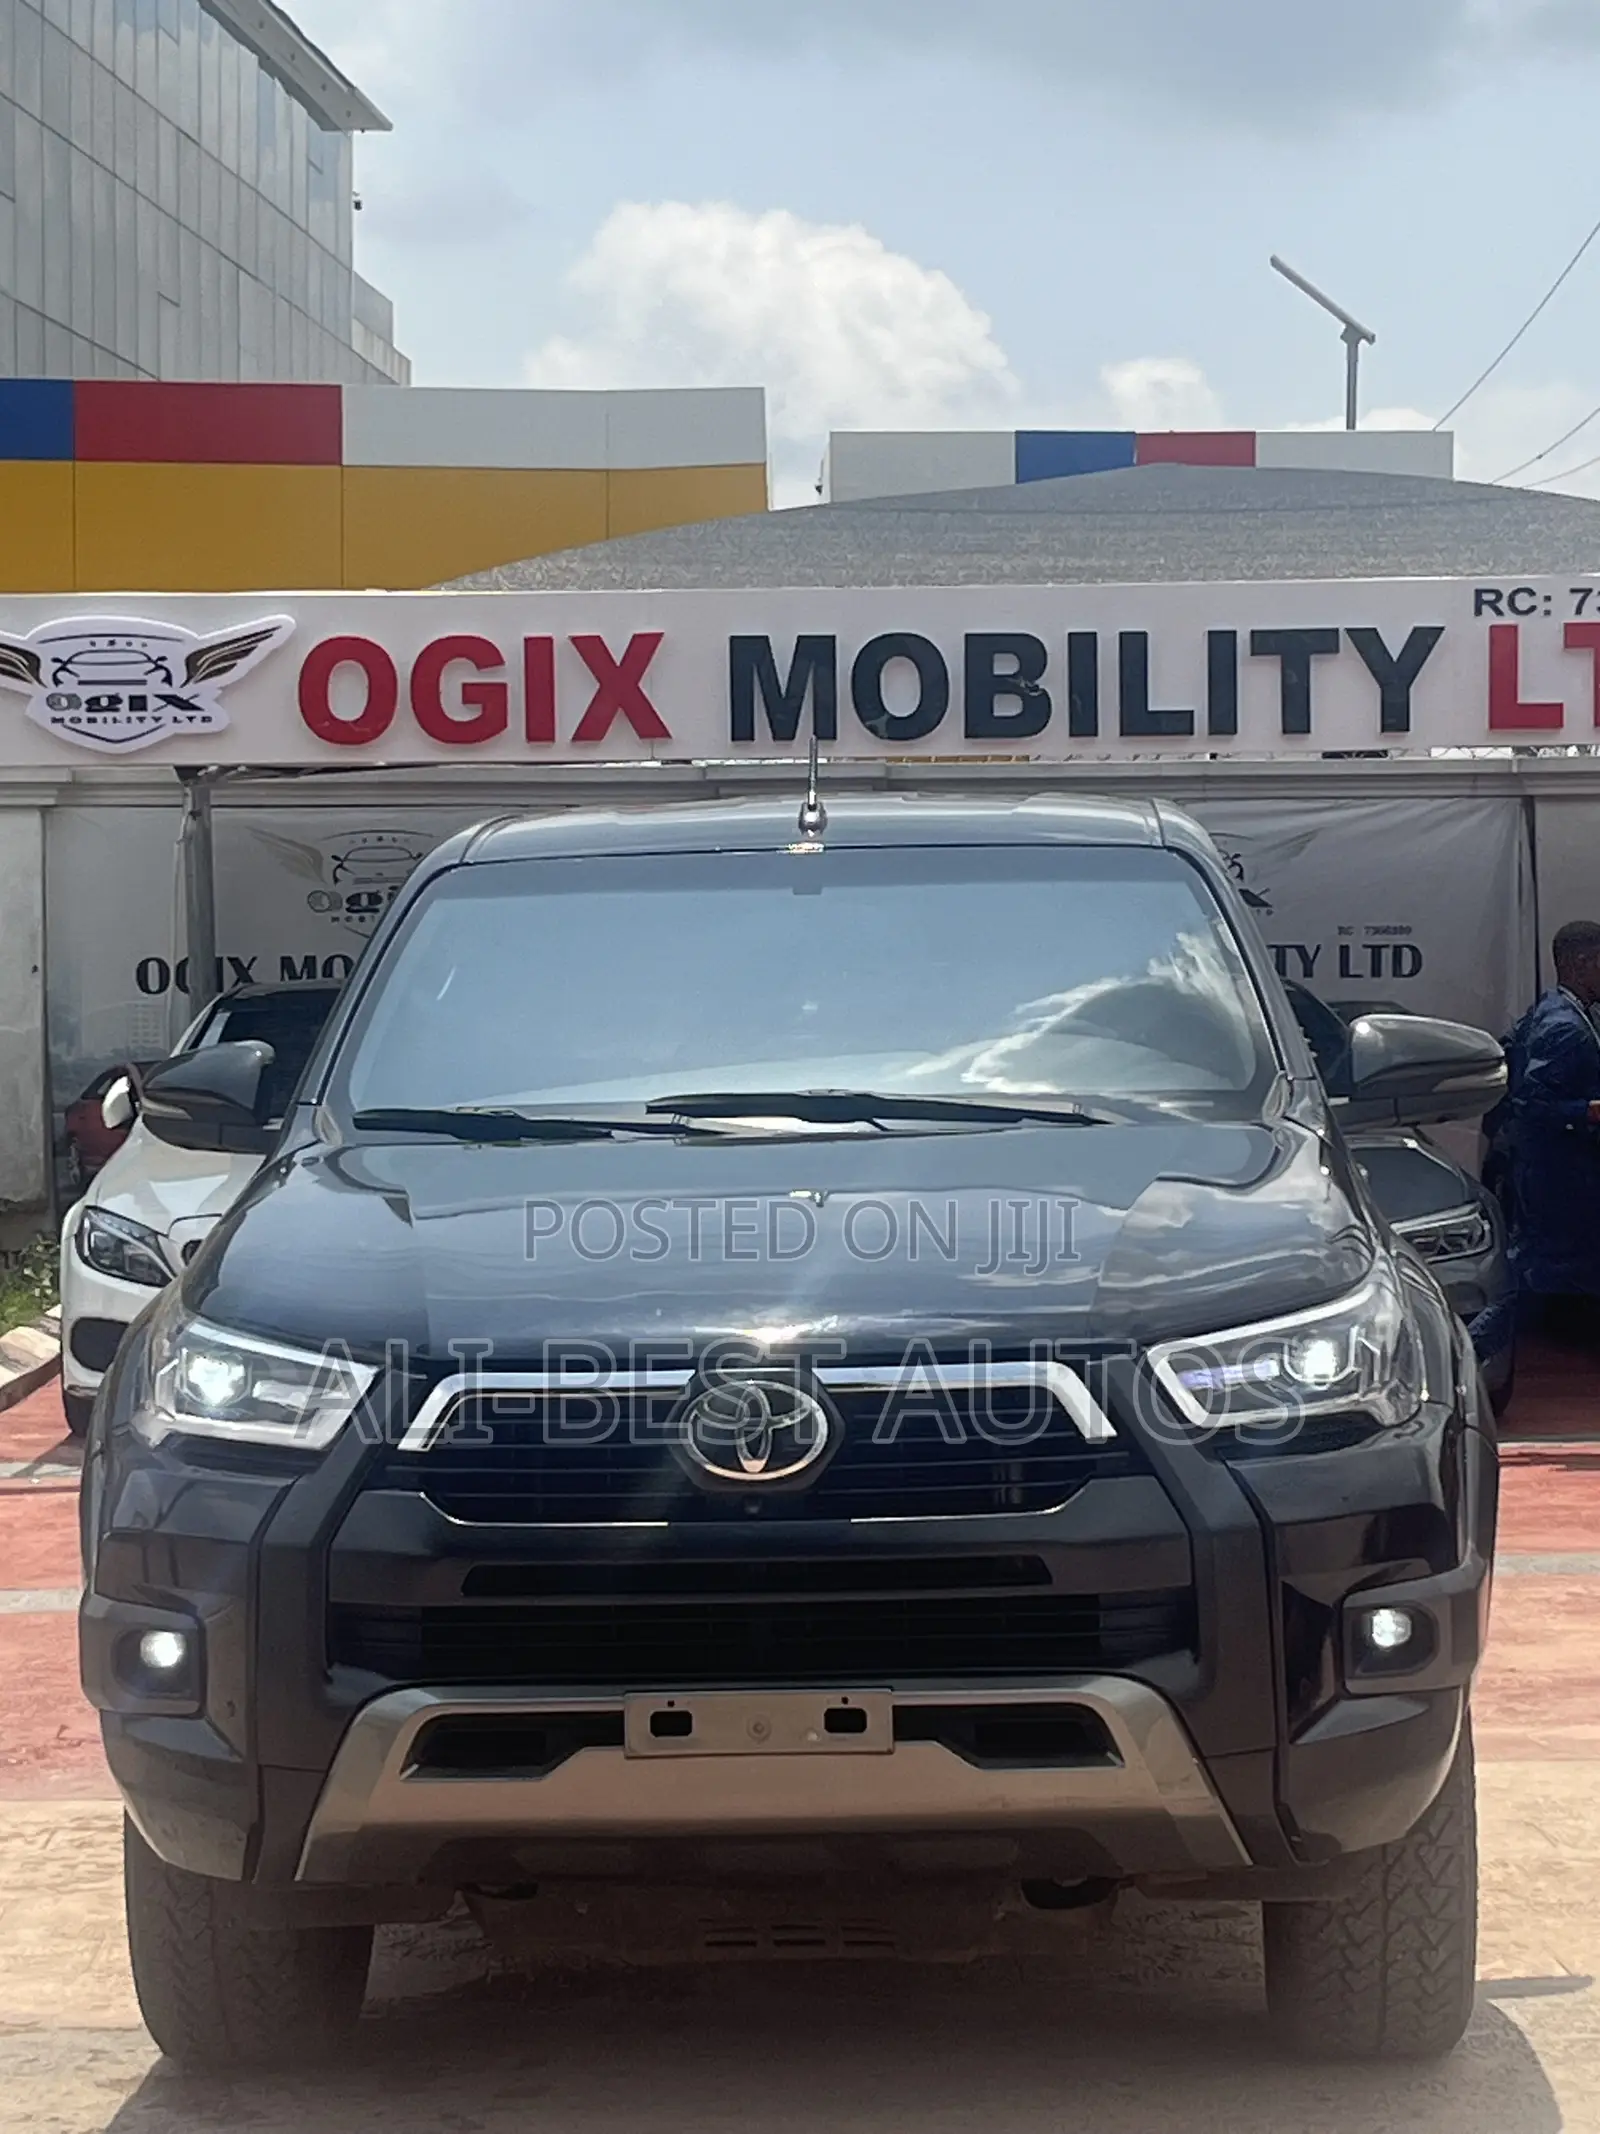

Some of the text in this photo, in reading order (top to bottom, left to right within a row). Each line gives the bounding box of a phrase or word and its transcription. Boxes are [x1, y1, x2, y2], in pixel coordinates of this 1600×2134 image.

[1474, 587, 1600, 617] RC: 7
[298, 622, 1600, 745] OGIX MOBILITY L
[50, 715, 163, 724] MOBILITY
[1338, 944, 1423, 978] LTD
